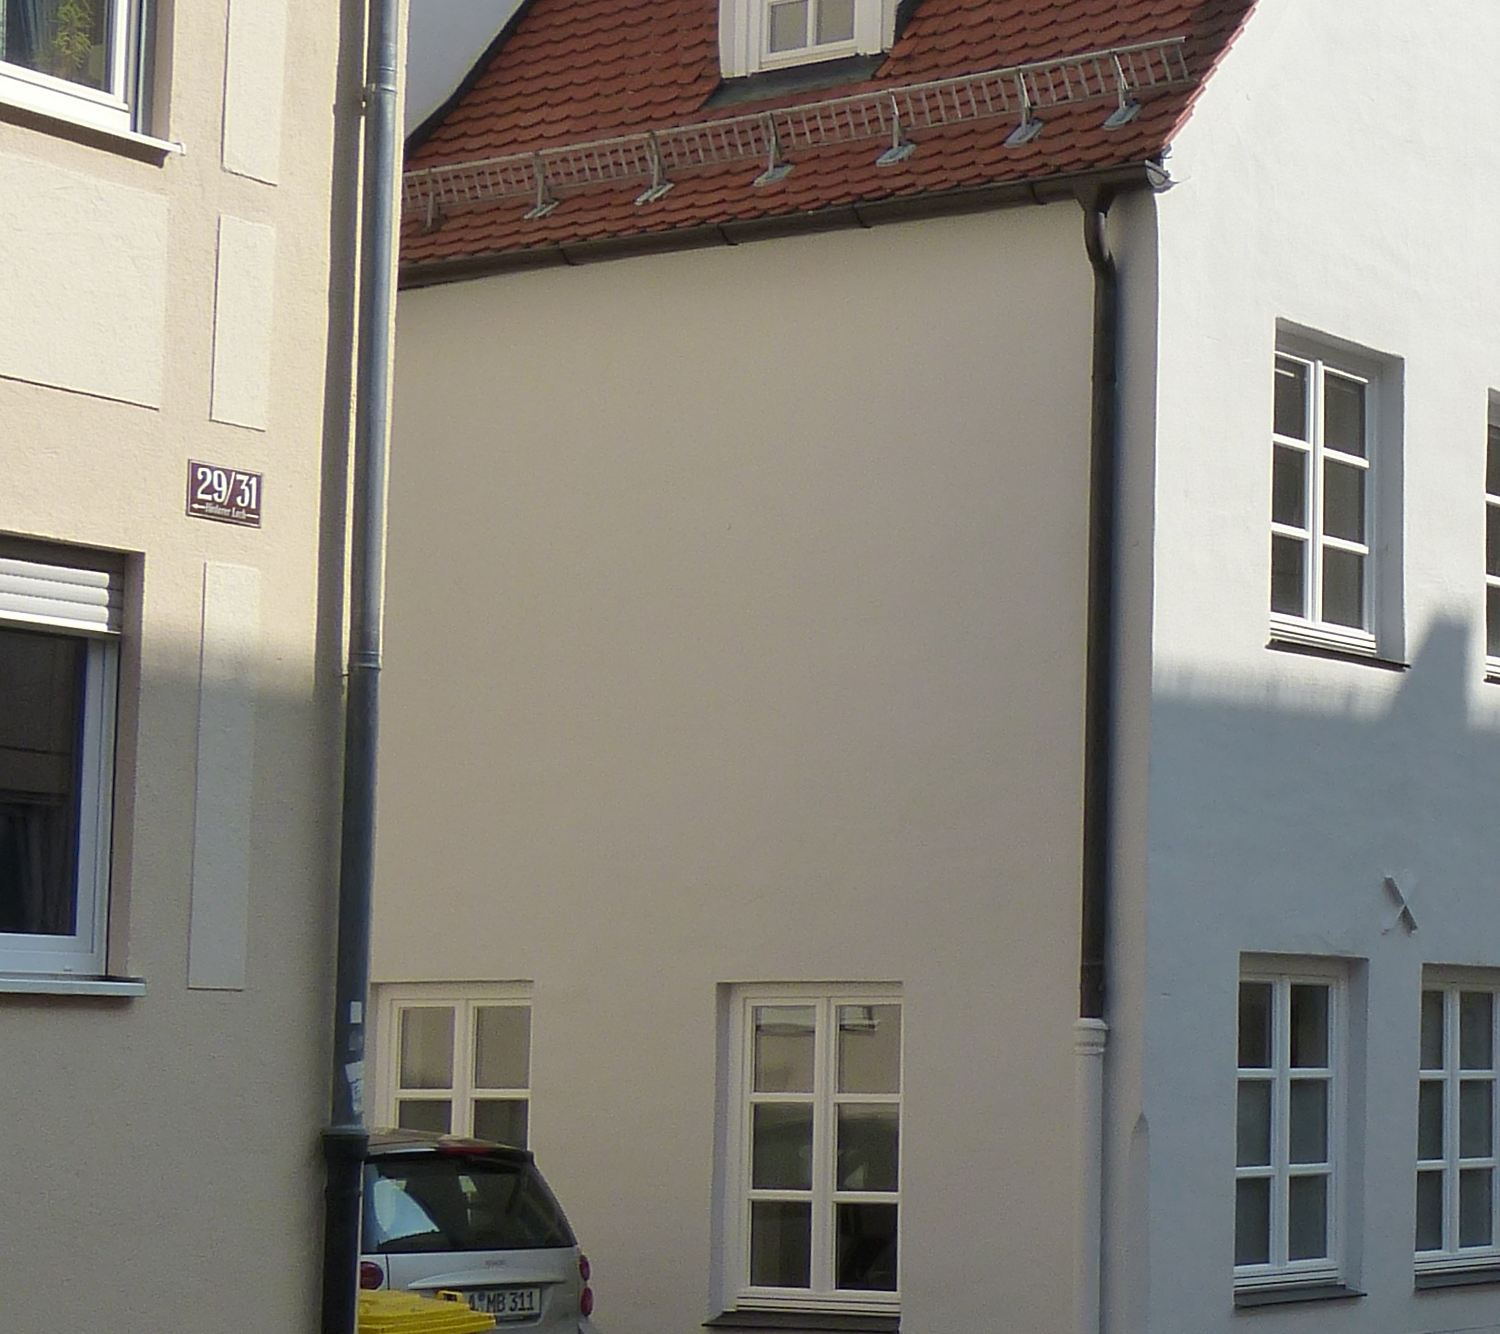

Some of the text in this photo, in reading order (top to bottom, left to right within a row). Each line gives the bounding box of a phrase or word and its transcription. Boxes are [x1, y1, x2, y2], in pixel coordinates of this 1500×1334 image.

[197, 467, 257, 509] 29/31
[486, 1292, 506, 1313] MB
[509, 1291, 534, 1312] 311
